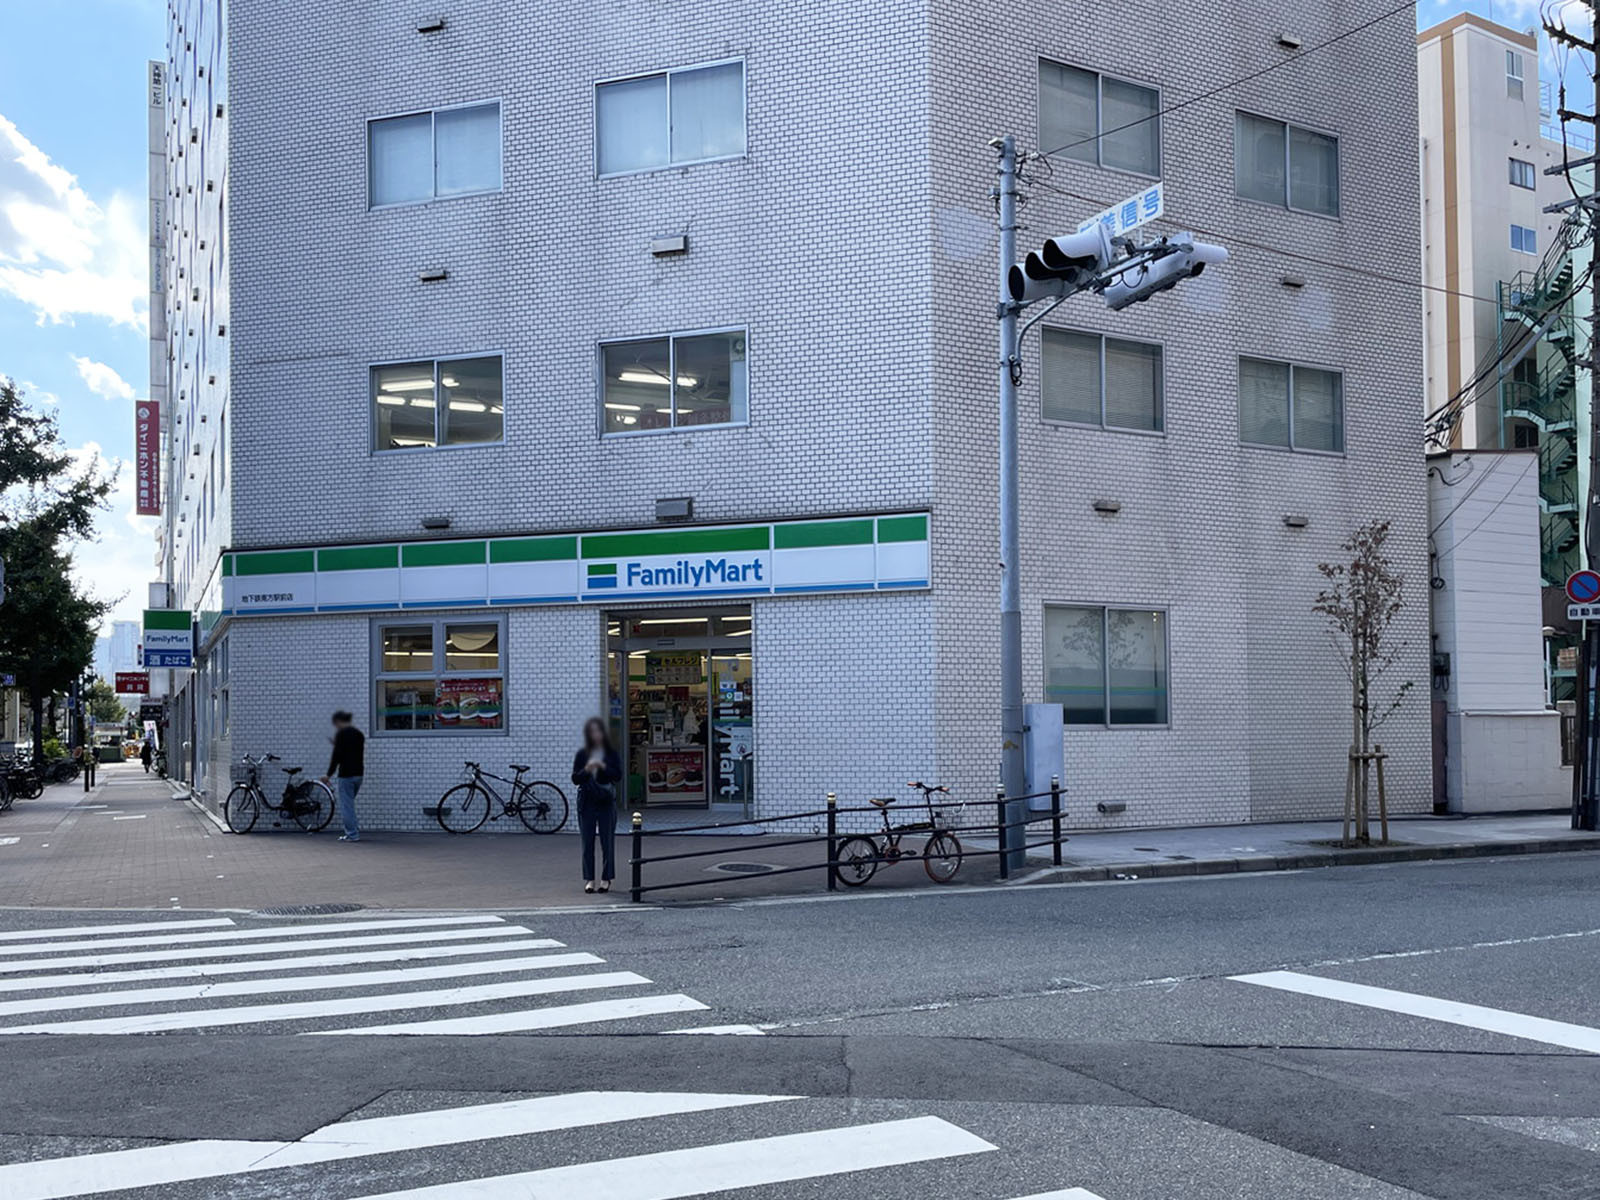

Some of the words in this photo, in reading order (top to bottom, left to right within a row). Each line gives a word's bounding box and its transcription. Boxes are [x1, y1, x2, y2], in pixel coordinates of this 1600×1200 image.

[627, 558, 763, 587] FamilyMart
[242, 593, 293, 602] 地下鉄南方駅前店
[147, 635, 188, 643] FamilyMart
[164, 656, 187, 665] たばこ
